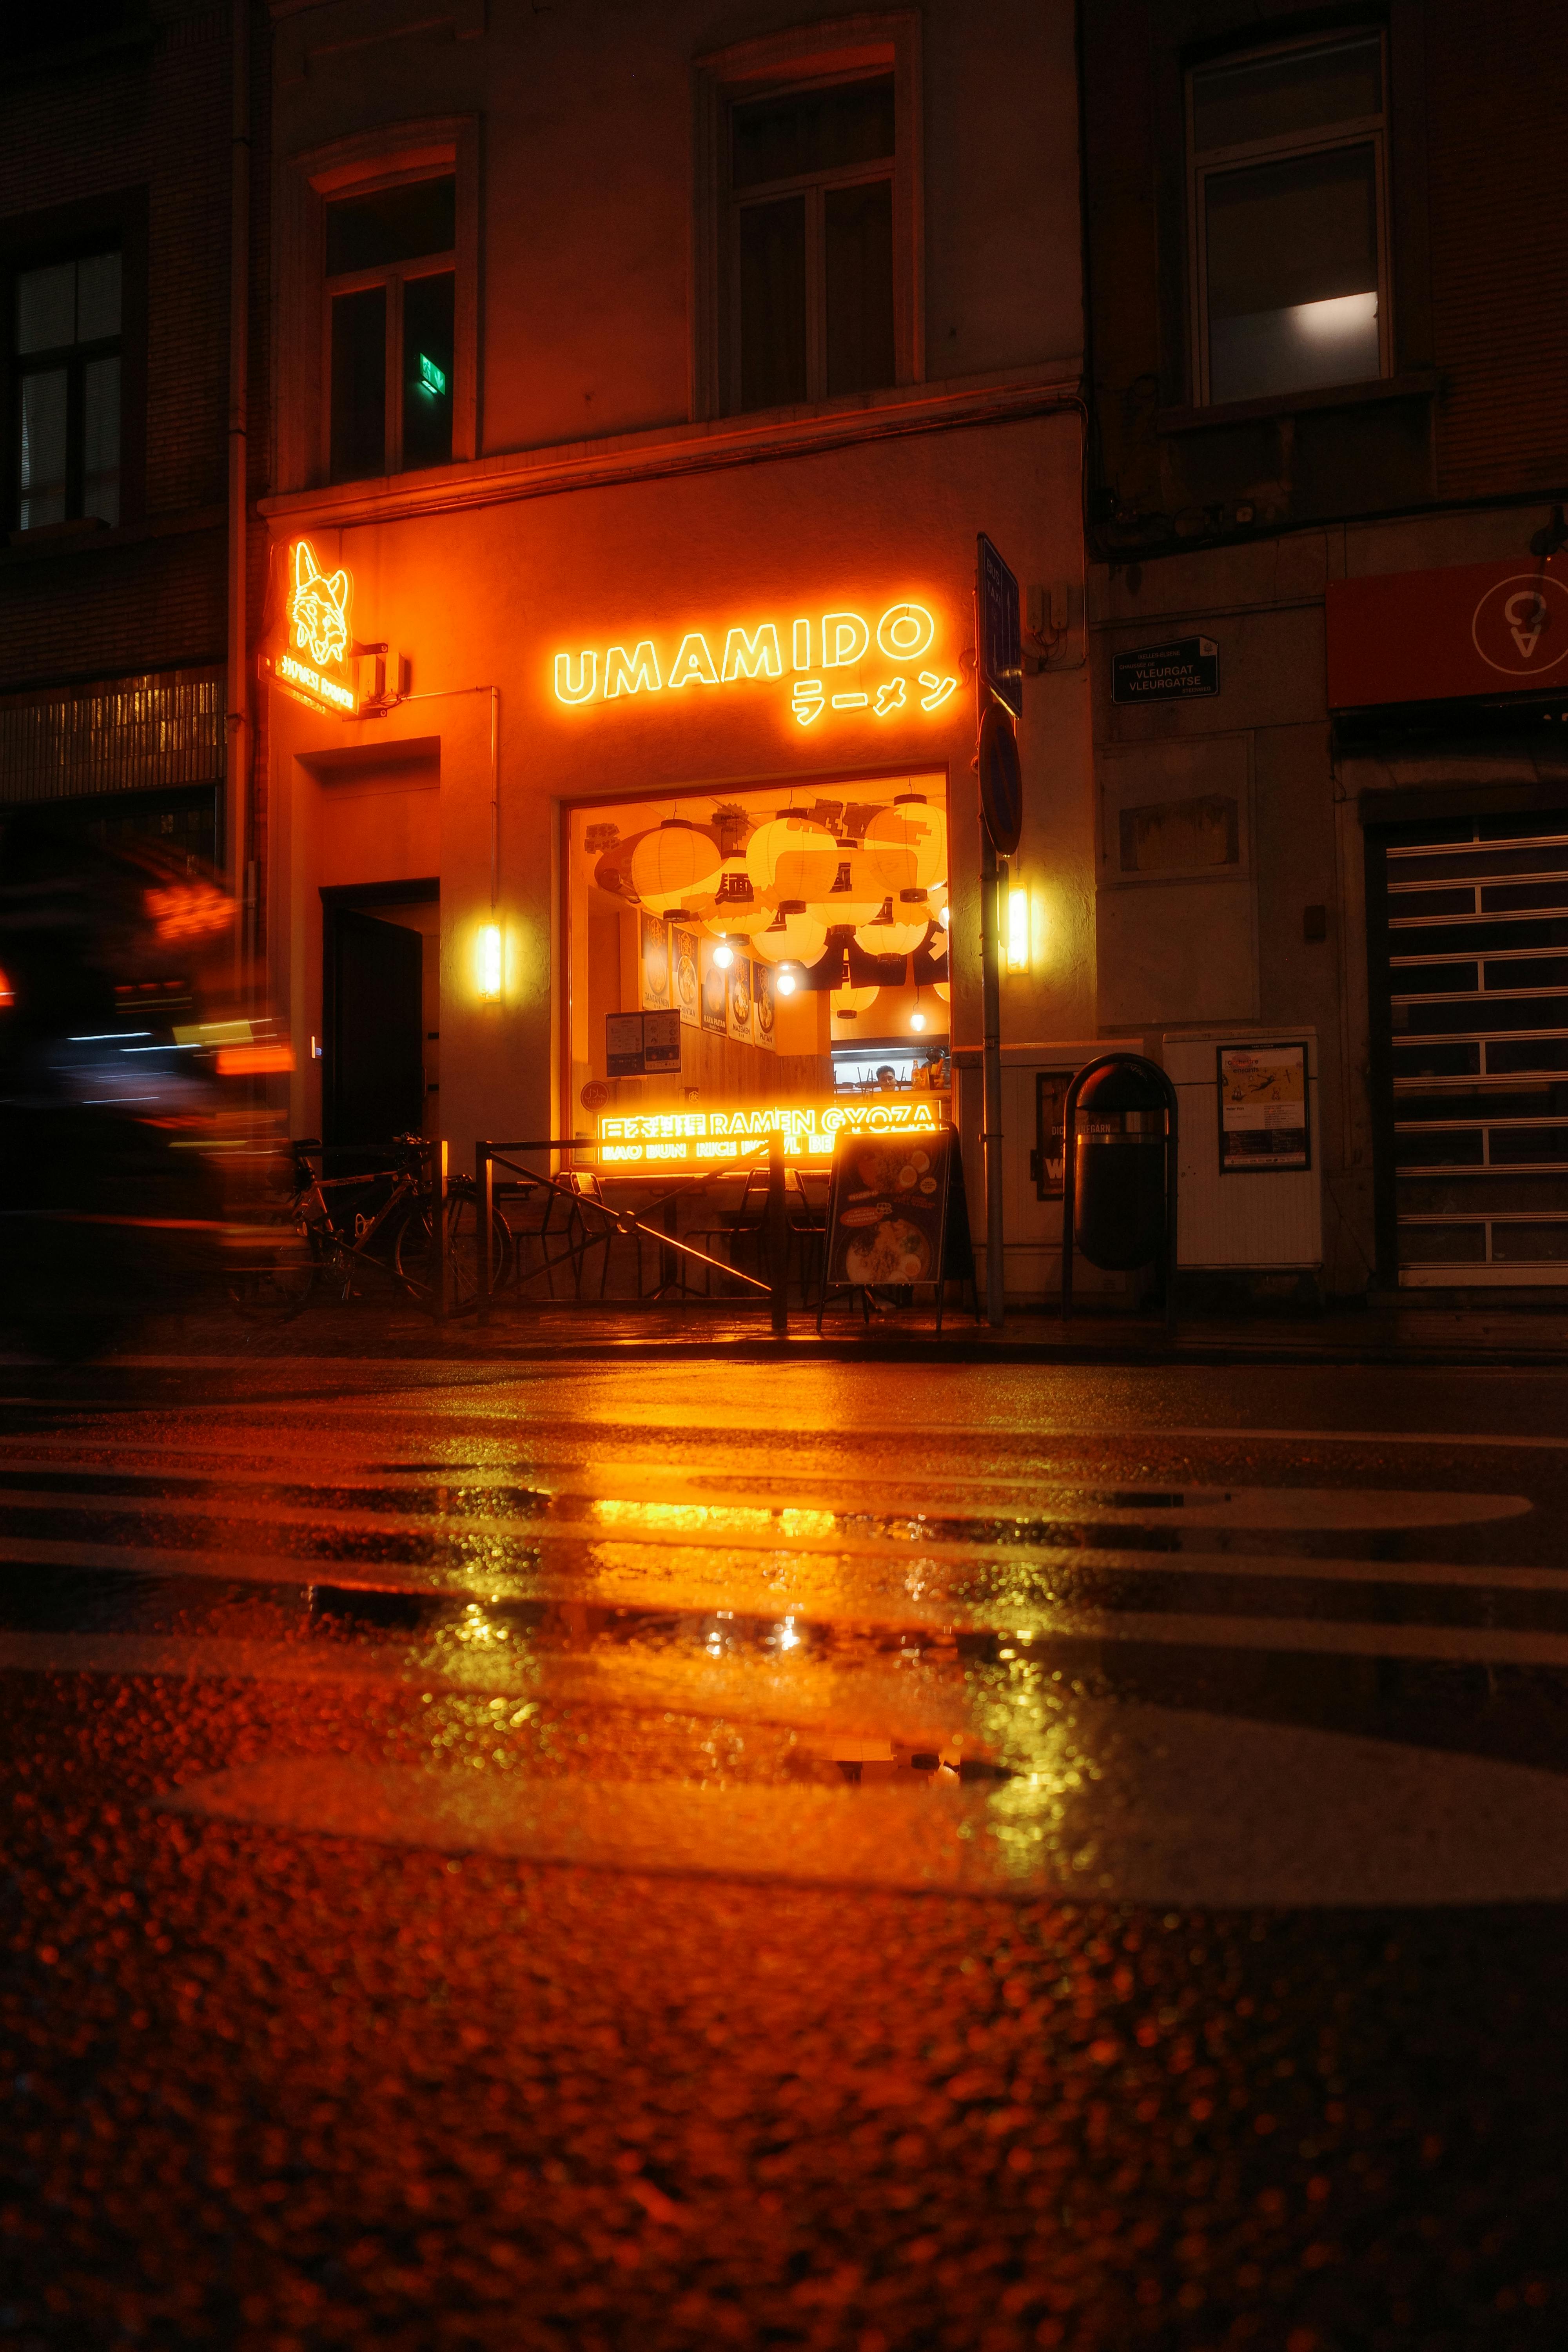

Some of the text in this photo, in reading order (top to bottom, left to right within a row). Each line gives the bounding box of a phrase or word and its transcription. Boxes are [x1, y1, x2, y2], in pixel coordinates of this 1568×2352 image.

[986, 557, 1000, 586] BUS
[986, 579, 1001, 608] TAXI
[554, 603, 935, 704] UMAMIDO
[1138, 650, 1180, 660] IXELLES-ELSENE
[281, 655, 319, 691] HONEST
[1136, 664, 1194, 679] VLEURGAT
[1129, 676, 1201, 691] VLEURGATSE
[791, 670, 957, 726] ラーメン
[645, 992, 670, 1008] TANTANMEN
[703, 1014, 713, 1024] KARA
[713, 1018, 726, 1029] PAITAN
[732, 1024, 750, 1035] MAZEMEN
[759, 1032, 773, 1043] PAITAN
[710, 1109, 815, 1136] RAMEN
[821, 1104, 936, 1135] GYOZA
[1052, 1125, 1063, 1135] DIC
[602, 1145, 642, 1161] BAO
[646, 1143, 687, 1159] BUN
[696, 1141, 737, 1157] RICE
